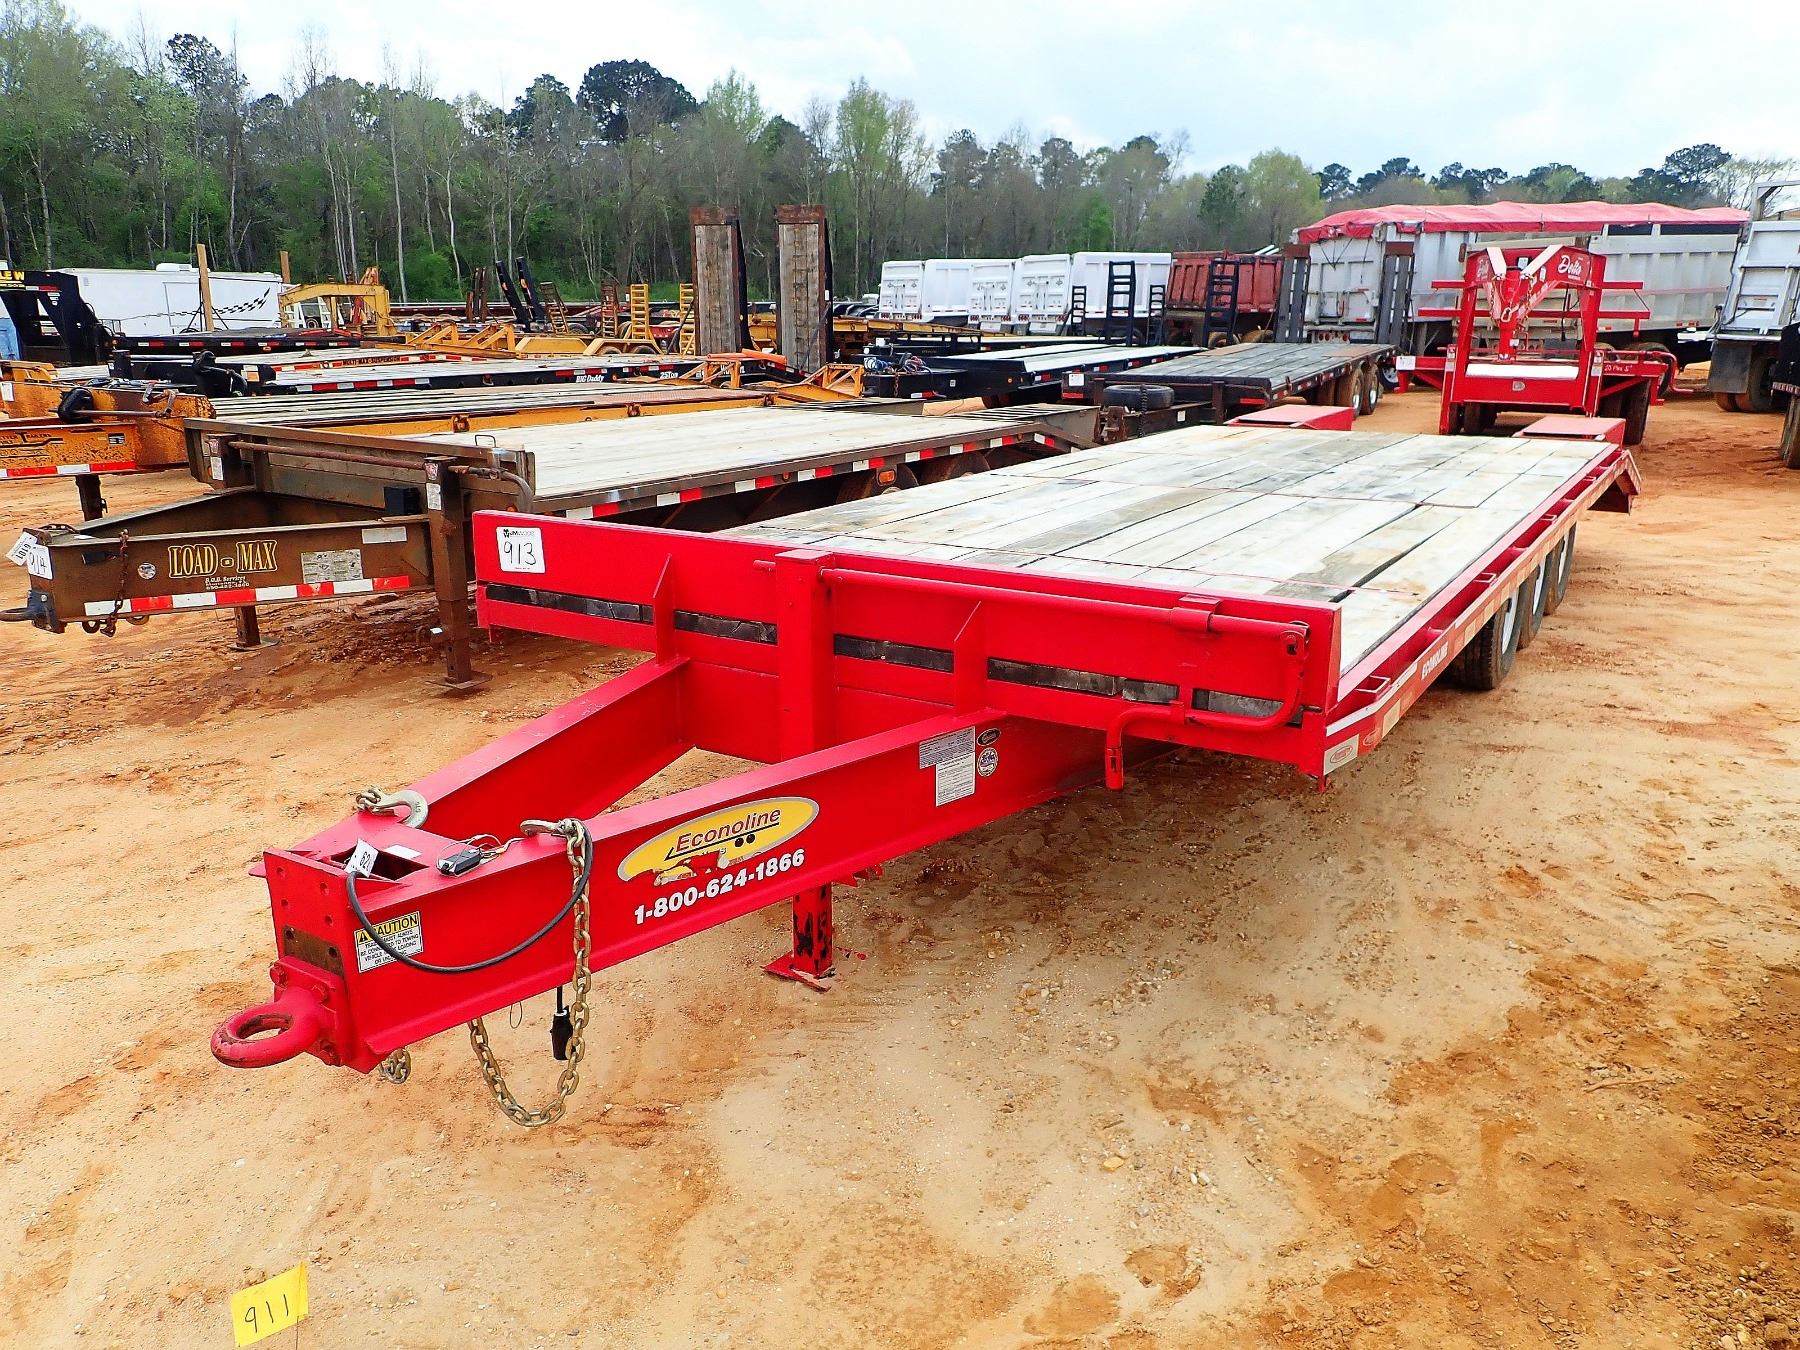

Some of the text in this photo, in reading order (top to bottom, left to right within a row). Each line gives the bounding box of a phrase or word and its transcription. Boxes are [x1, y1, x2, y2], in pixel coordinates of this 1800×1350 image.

[168, 544, 219, 578] LOAD
[236, 540, 278, 573] MAX
[503, 541, 537, 566] 913
[675, 808, 781, 852] Econoline
[634, 848, 805, 925] 1-800-624-1866
[374, 914, 417, 936] AUTION
[244, 1293, 289, 1334] 911
